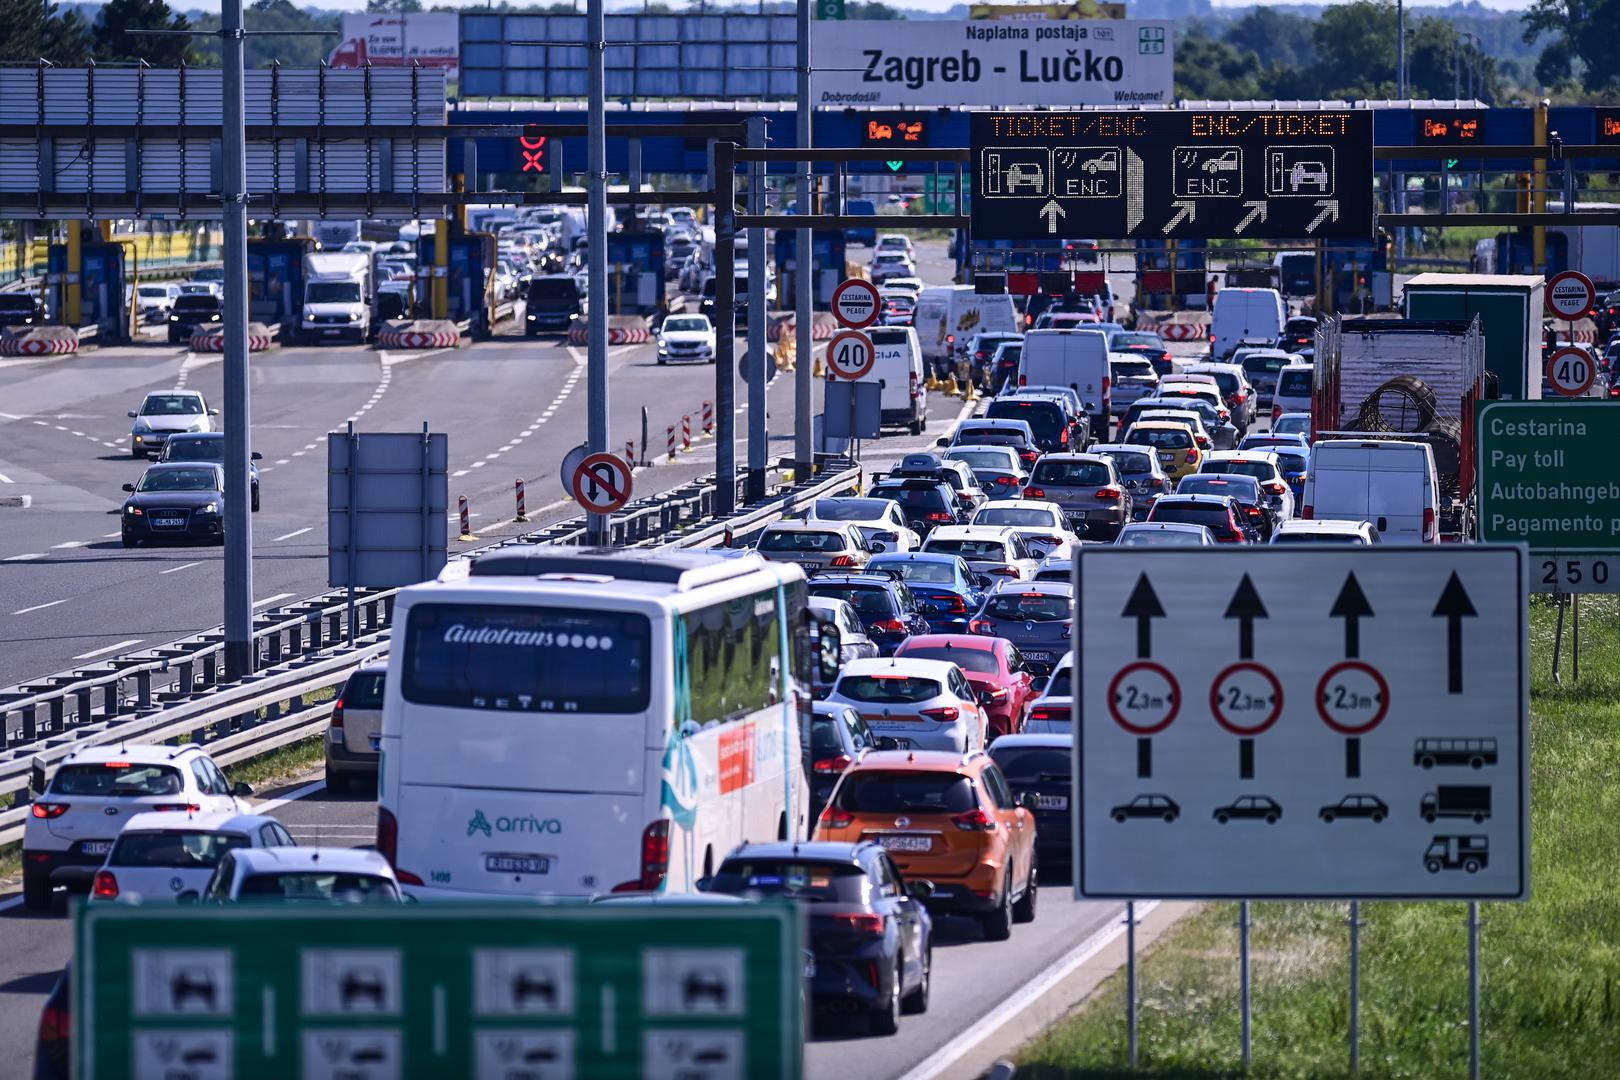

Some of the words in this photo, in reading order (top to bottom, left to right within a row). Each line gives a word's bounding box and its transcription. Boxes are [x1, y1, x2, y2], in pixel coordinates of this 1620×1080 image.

[966, 25, 1029, 42] Naplatna
[1035, 25, 1088, 42] postaja
[862, 49, 981, 90] Zagreb
[1020, 49, 1124, 83] Lučko
[821, 91, 881, 102] Dobrodošli!
[1114, 90, 1164, 102] Welcome!
[990, 116, 1146, 136] TICKET/ENC
[1192, 115, 1350, 136] ENC/TICKET
[1067, 179, 1108, 195] ENC
[1187, 178, 1229, 194] ENC
[846, 307, 867, 315] PEAGE
[837, 344, 865, 367] 40
[1557, 361, 1586, 384] 40
[1491, 418, 1587, 436] Cestarina
[1491, 450, 1527, 472] Pay
[1534, 450, 1564, 467] toll
[1492, 514, 1603, 535] Pagamento
[495, 814, 562, 834] arriva
